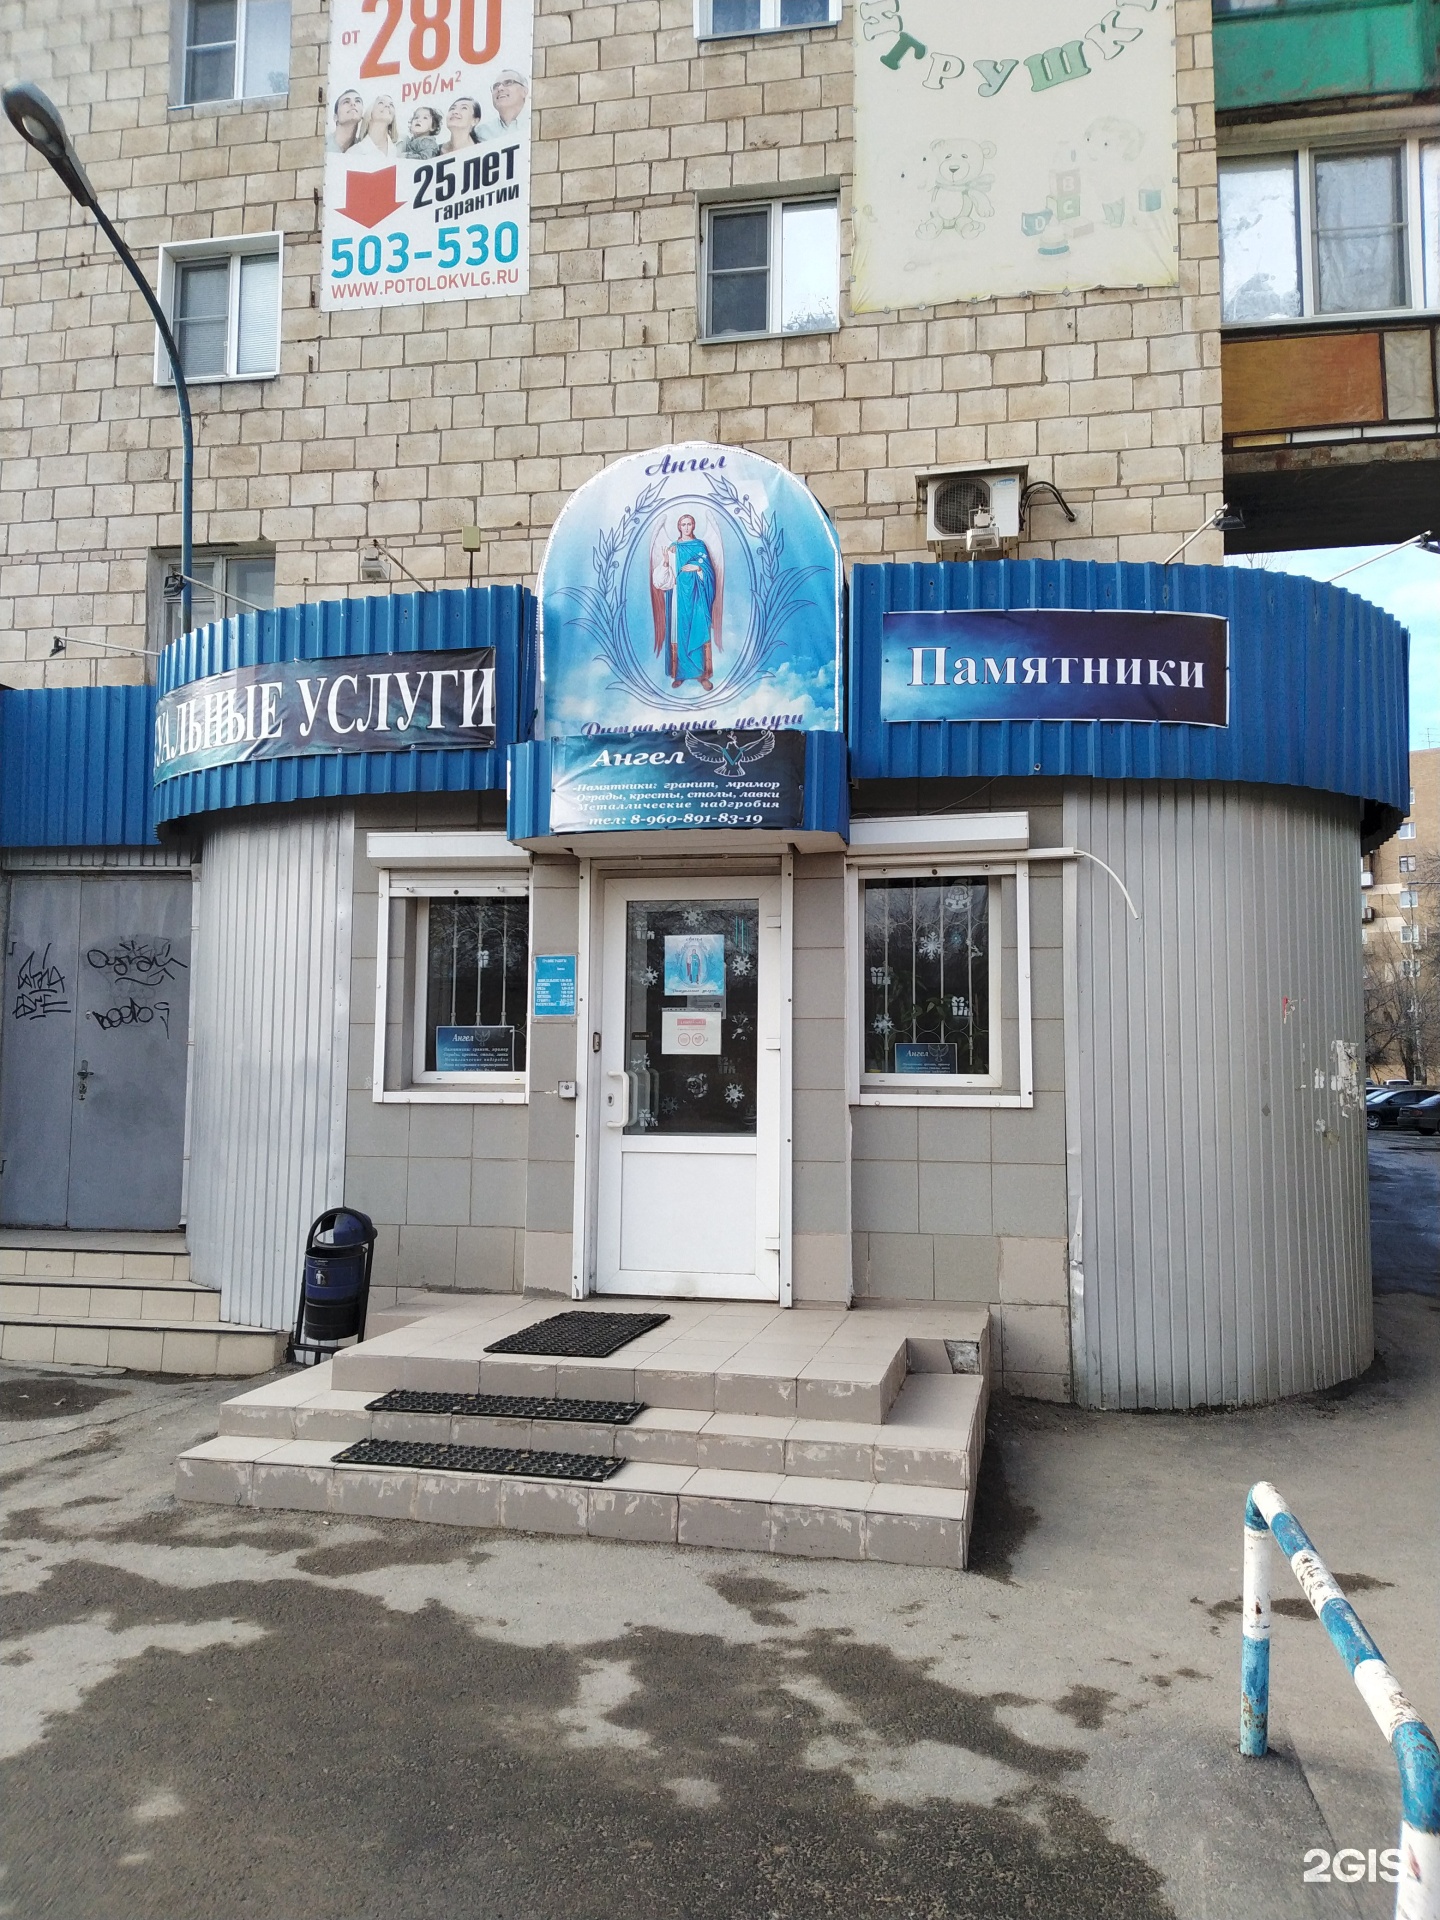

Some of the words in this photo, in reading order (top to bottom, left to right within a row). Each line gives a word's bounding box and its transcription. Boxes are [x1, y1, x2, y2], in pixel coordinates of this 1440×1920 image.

[342, 30, 361, 45] от
[360, 0, 502, 79] 280
[860, 0, 1157, 97] ИГРУШК
[413, 157, 456, 209] 25
[434, 184, 520, 223] гарантии
[331, 221, 519, 278] 503-530
[332, 268, 519, 299] WWW.POTOLOKVLG.RU
[645, 454, 727, 476] Ангел
[906, 646, 1205, 688] Памятники
[296, 667, 496, 737] УСЛУГИ
[735, 714, 803, 730] услуги
[589, 749, 685, 768] Ангел
[572, 783, 657, 792] -Памятники:
[663, 782, 719, 790] гранит,
[725, 781, 780, 789] мрамор
[629, 792, 684, 800] кресты,
[687, 791, 737, 799] столы,
[700, 799, 780, 809] надгробия
[589, 817, 627, 825] тел:
[630, 812, 763, 825] 8-960-891-83-19
[452, 1033, 474, 1042] Ангел
